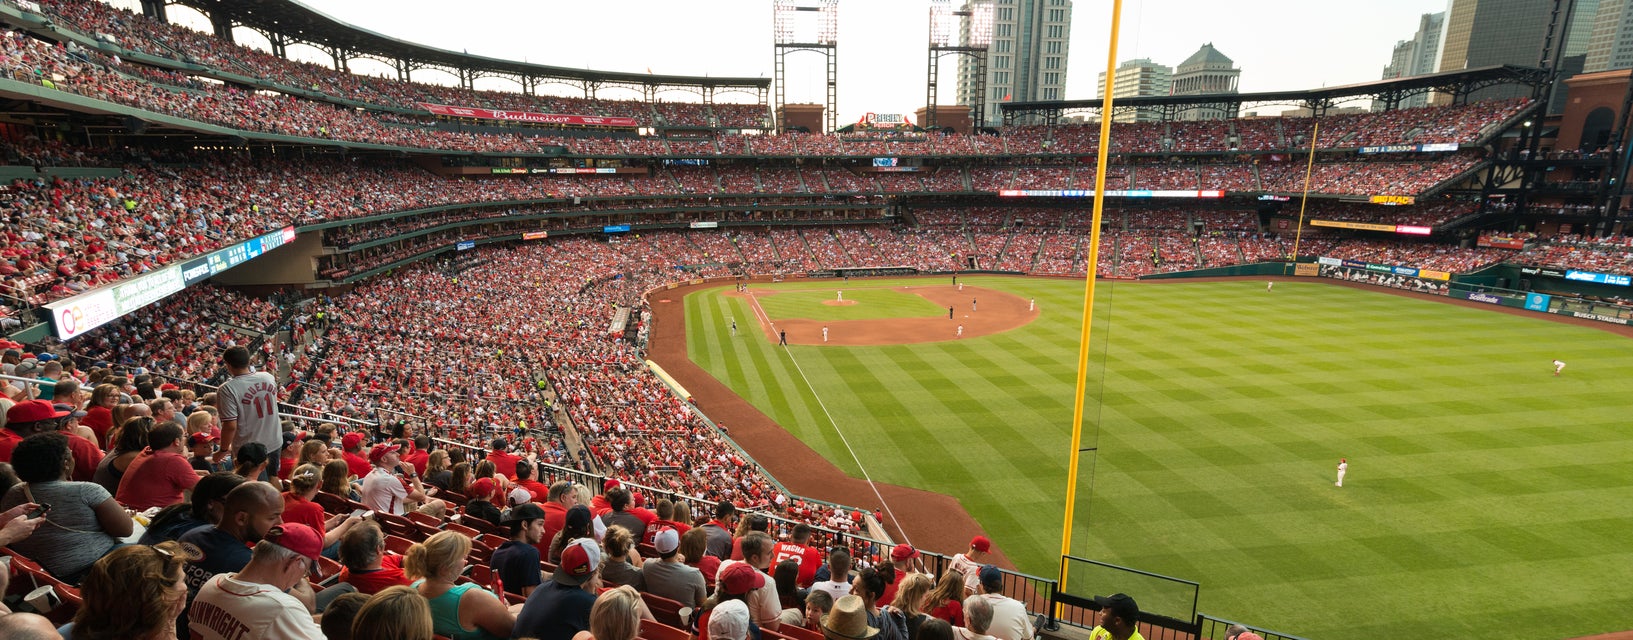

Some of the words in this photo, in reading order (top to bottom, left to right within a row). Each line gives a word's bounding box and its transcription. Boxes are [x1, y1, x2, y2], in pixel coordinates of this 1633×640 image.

[492, 110, 569, 122] Budweiser
[1388, 195, 1409, 205] MAC
[1522, 267, 1538, 275] Mercy
[1469, 293, 1499, 304] Scottrade
[1573, 311, 1596, 320] BUSCH
[1596, 314, 1627, 325] STADIUM
[253, 393, 274, 419] 11
[781, 544, 806, 555] WACHA
[188, 601, 250, 640] AINWRIGHT
